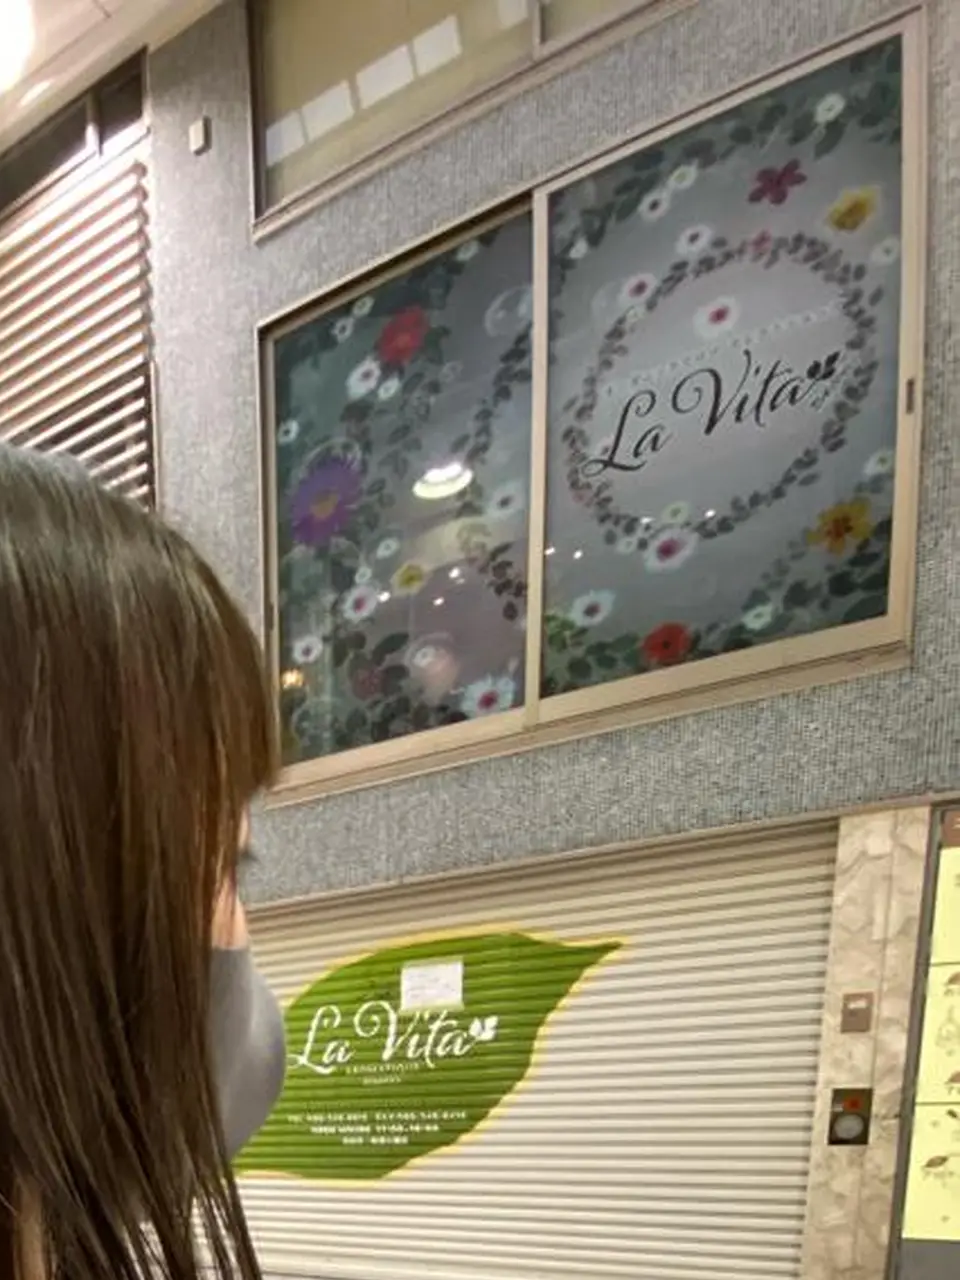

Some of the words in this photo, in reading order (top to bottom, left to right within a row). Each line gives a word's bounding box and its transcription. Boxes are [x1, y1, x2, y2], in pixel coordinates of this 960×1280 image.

[583, 388, 677, 476] La
[672, 350, 824, 437] Vita
[286, 1003, 356, 1075] La
[354, 1000, 476, 1069] Vita
